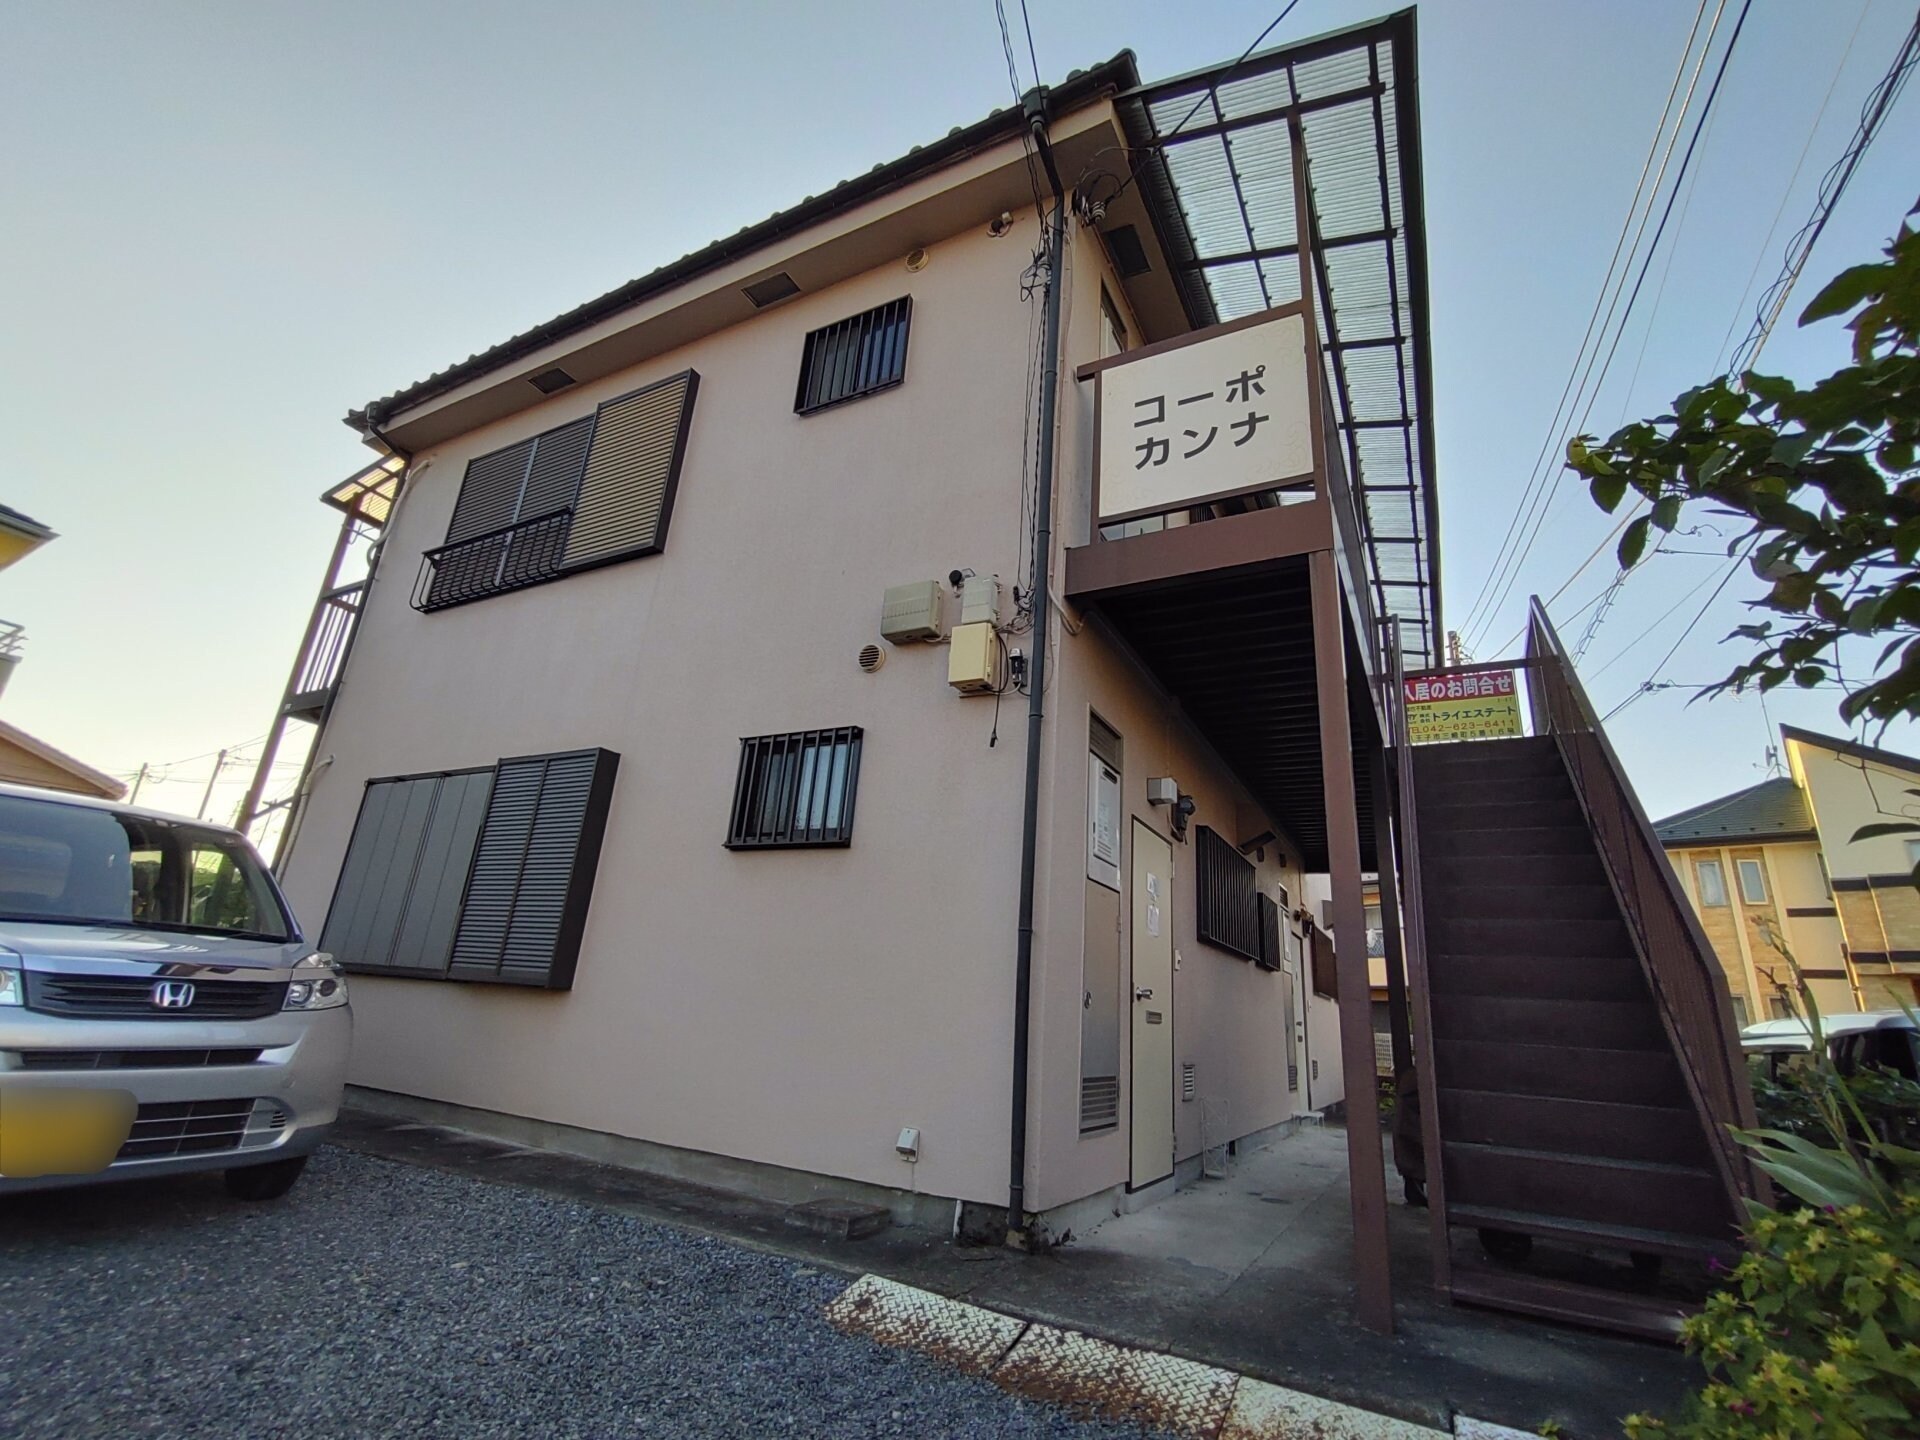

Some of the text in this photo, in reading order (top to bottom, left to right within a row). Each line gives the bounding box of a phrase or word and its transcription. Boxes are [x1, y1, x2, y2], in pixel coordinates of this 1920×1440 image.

[1134, 364, 1266, 428] コーポ
[1135, 411, 1270, 470] カンナ
[1433, 706, 1516, 722] トライエステート
